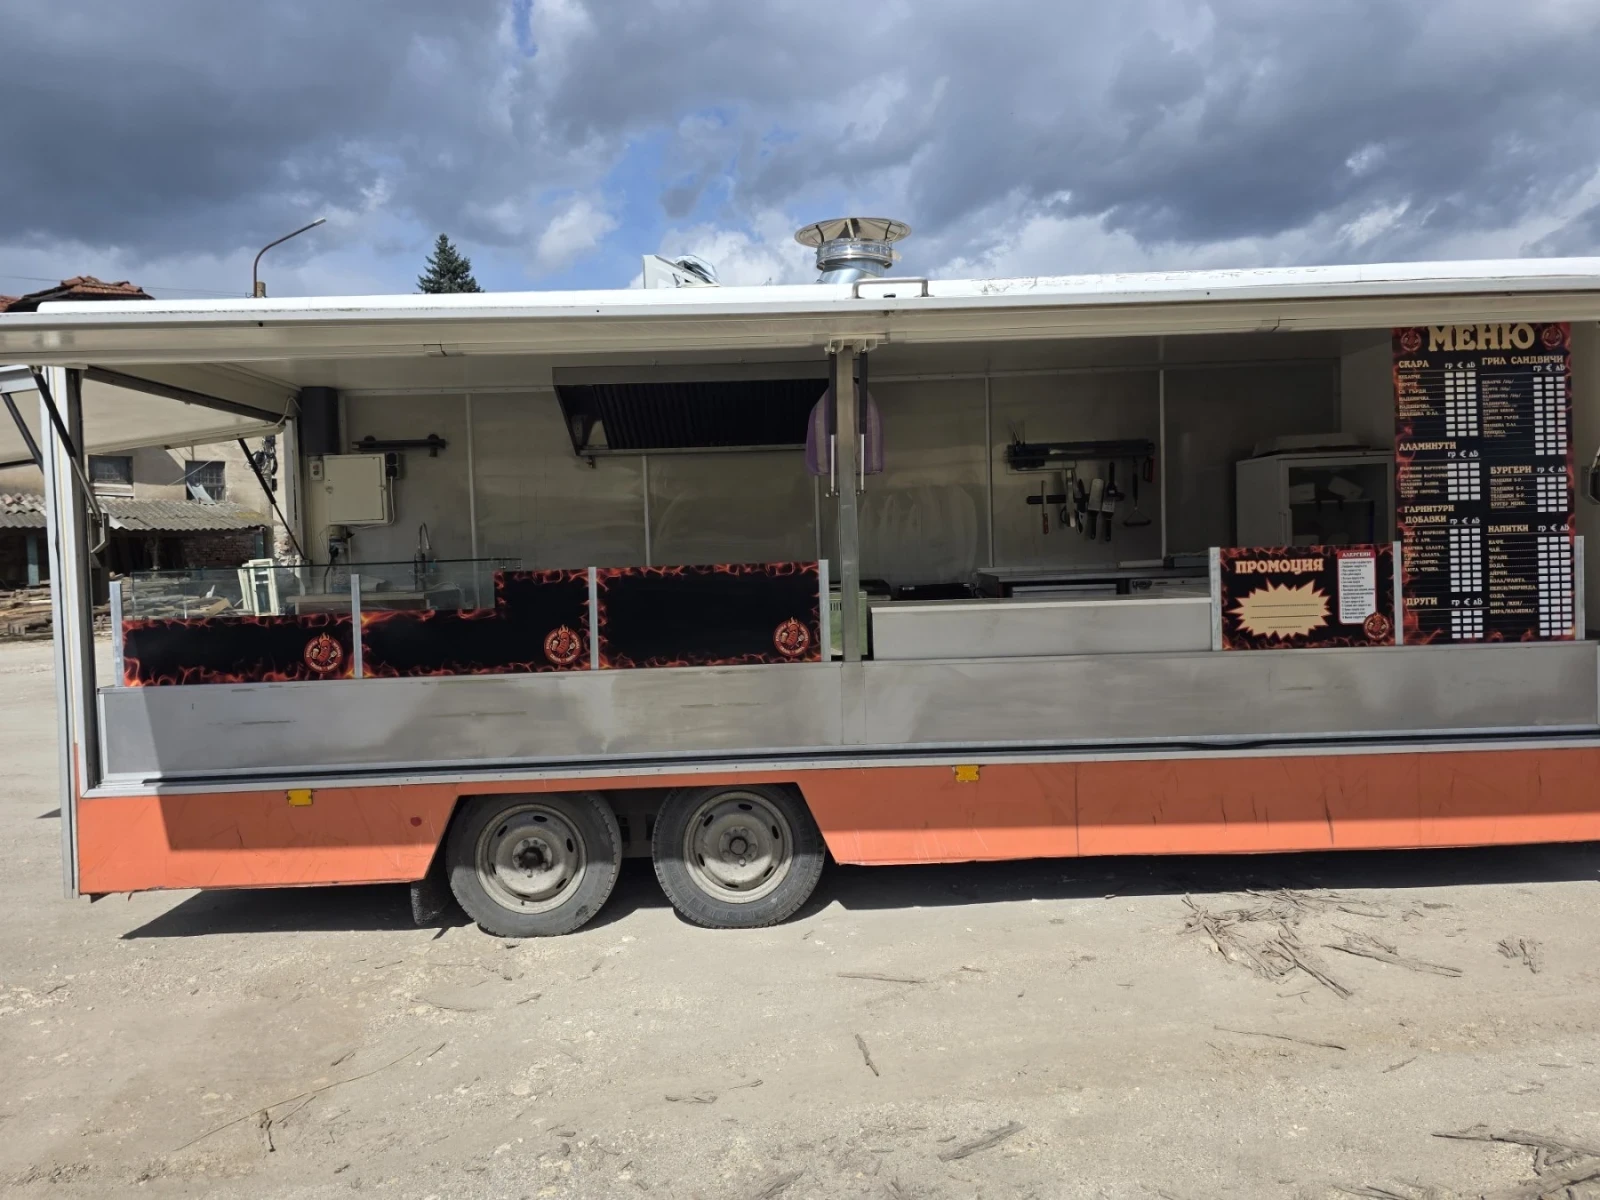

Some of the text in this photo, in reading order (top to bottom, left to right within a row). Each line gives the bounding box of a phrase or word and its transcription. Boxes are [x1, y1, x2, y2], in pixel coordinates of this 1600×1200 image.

[1428, 324, 1535, 352] МЕНЮ
[1398, 360, 1429, 368] СКАРА
[1482, 356, 1564, 366] ГРИЛ САНДВИЧИ
[1399, 442, 1456, 451] АЛАМИНУТИ
[1490, 465, 1532, 474] БУРГЕРИ
[1404, 504, 1454, 513] ГАРНИТУРИ
[1405, 515, 1447, 524] ДОБАВКИ
[1488, 524, 1529, 533] НАПИТКИ
[1550, 524, 1557, 532] €
[1235, 558, 1324, 575] ПРОМОЦИЯ
[1406, 597, 1438, 606] ДРУГИ
[1452, 599, 1460, 607] гр
